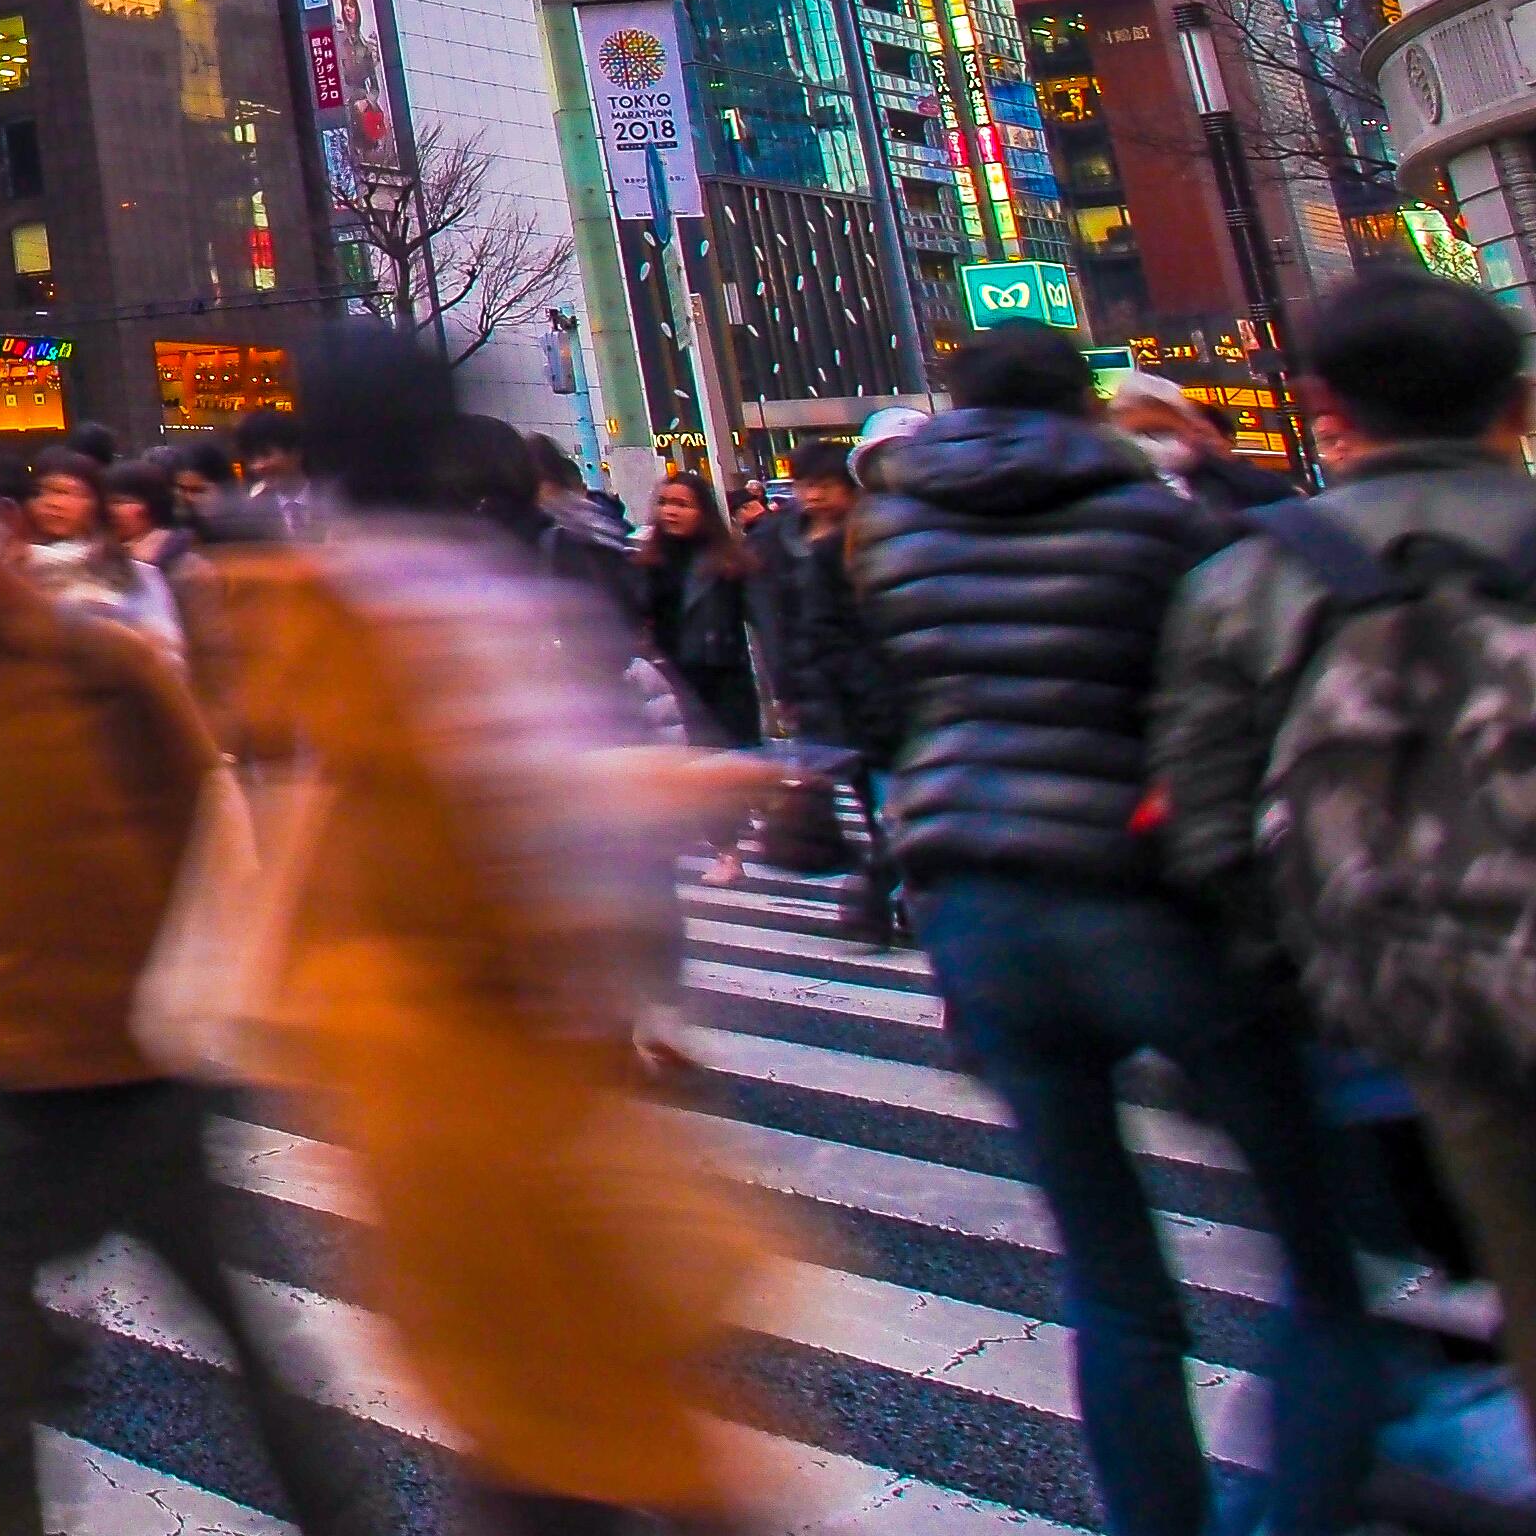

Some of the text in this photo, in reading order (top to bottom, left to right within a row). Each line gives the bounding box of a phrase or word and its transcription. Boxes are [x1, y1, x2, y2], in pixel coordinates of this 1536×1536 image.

[607, 93, 671, 109] TOKYO
[611, 108, 673, 120] MARATHON
[613, 119, 676, 141] 2018
